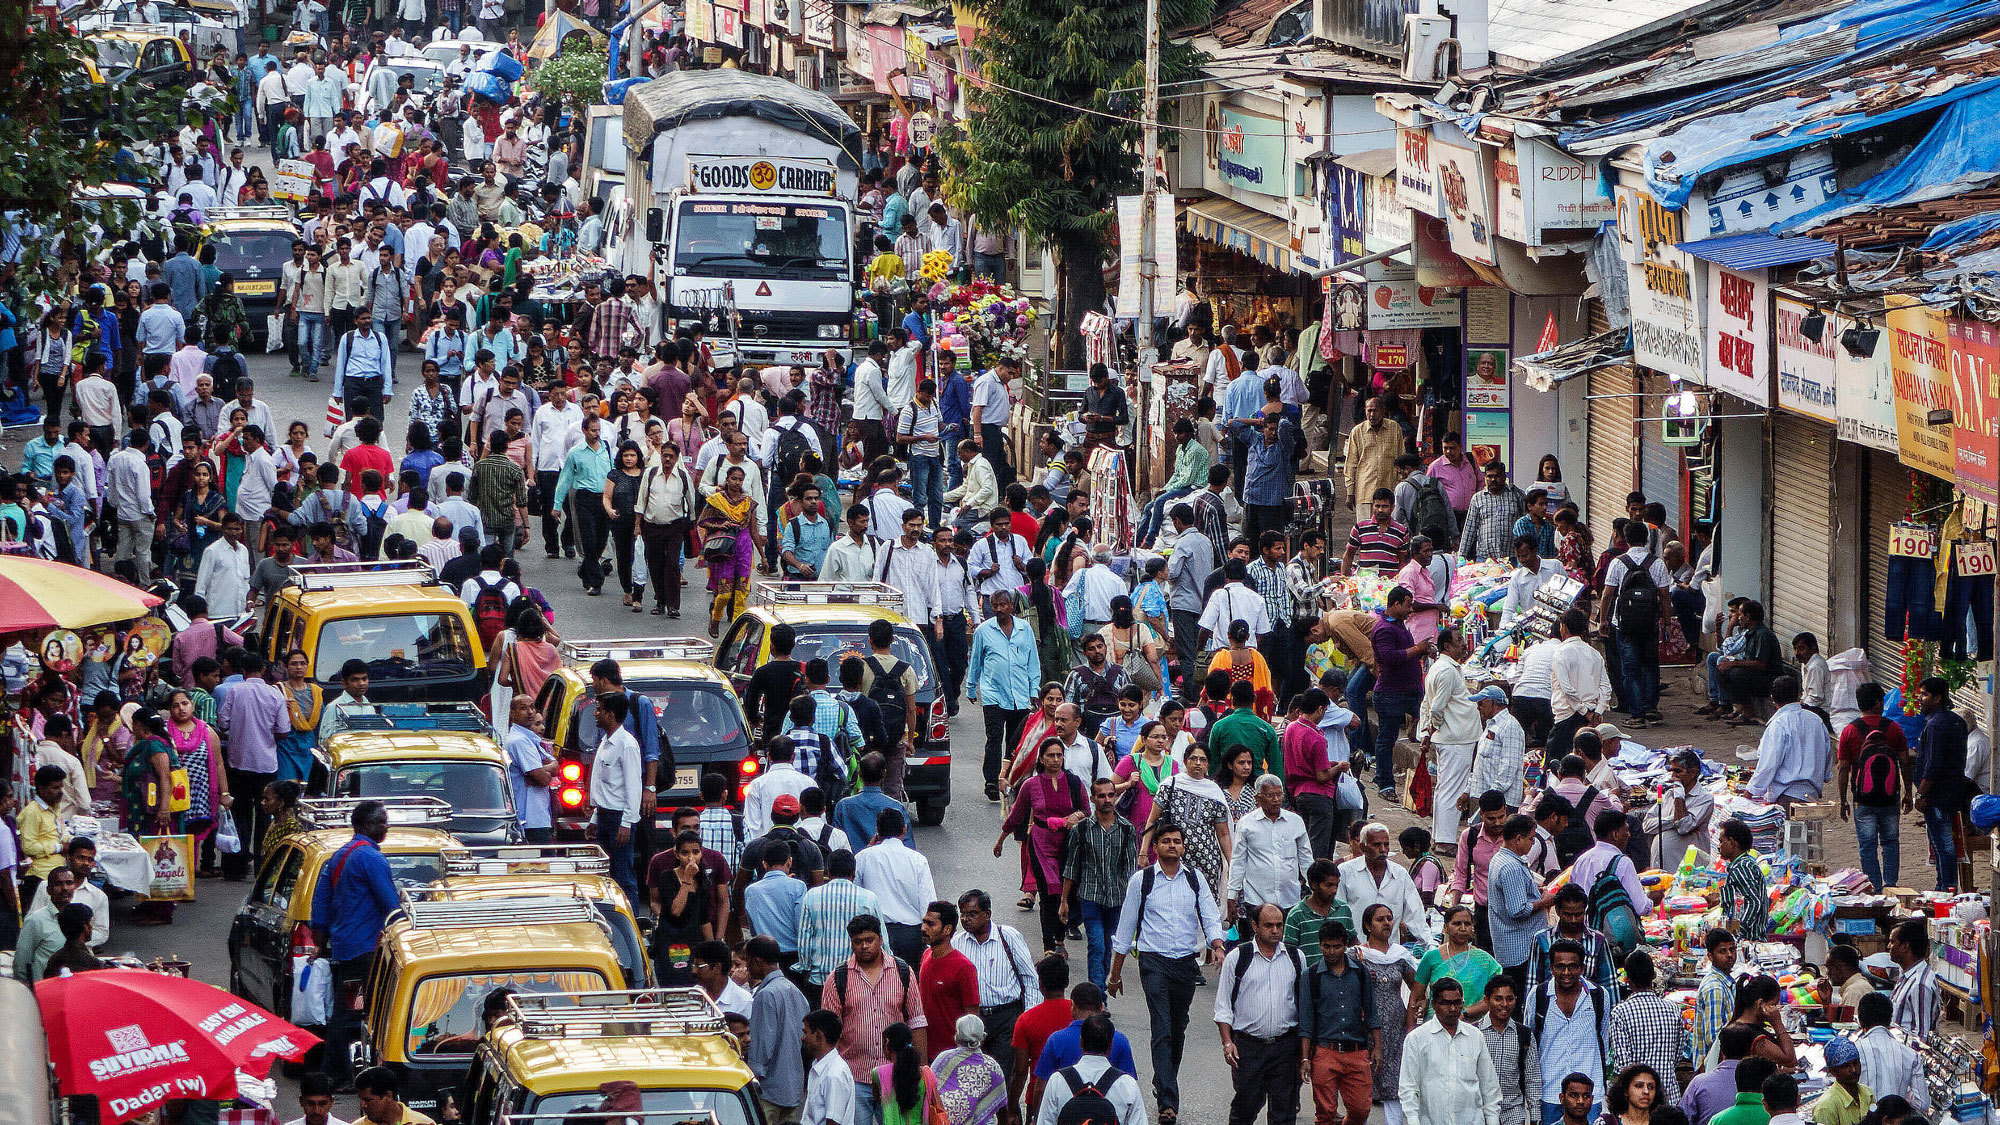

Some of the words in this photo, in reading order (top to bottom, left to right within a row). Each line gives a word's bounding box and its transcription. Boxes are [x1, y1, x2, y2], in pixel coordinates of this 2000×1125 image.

[211, 31, 222, 43] NO
[700, 165, 749, 188] GOODS
[779, 165, 831, 191] CARRIER
[1542, 163, 1596, 181] RIDDHI
[1388, 355, 1405, 365] 170
[1894, 368, 1929, 410] SADHANA
[1893, 537, 1929, 556] 190
[1959, 554, 1994, 574] 190
[153, 866, 184, 881] angoli
[198, 1009, 226, 1033] EASY
[225, 1002, 247, 1019] EMI
[214, 1012, 268, 1046] AVAILABLE
[89, 1042, 188, 1076] SUVIDHA
[110, 1065, 146, 1078] Complete
[109, 1081, 171, 1117] Dadar
